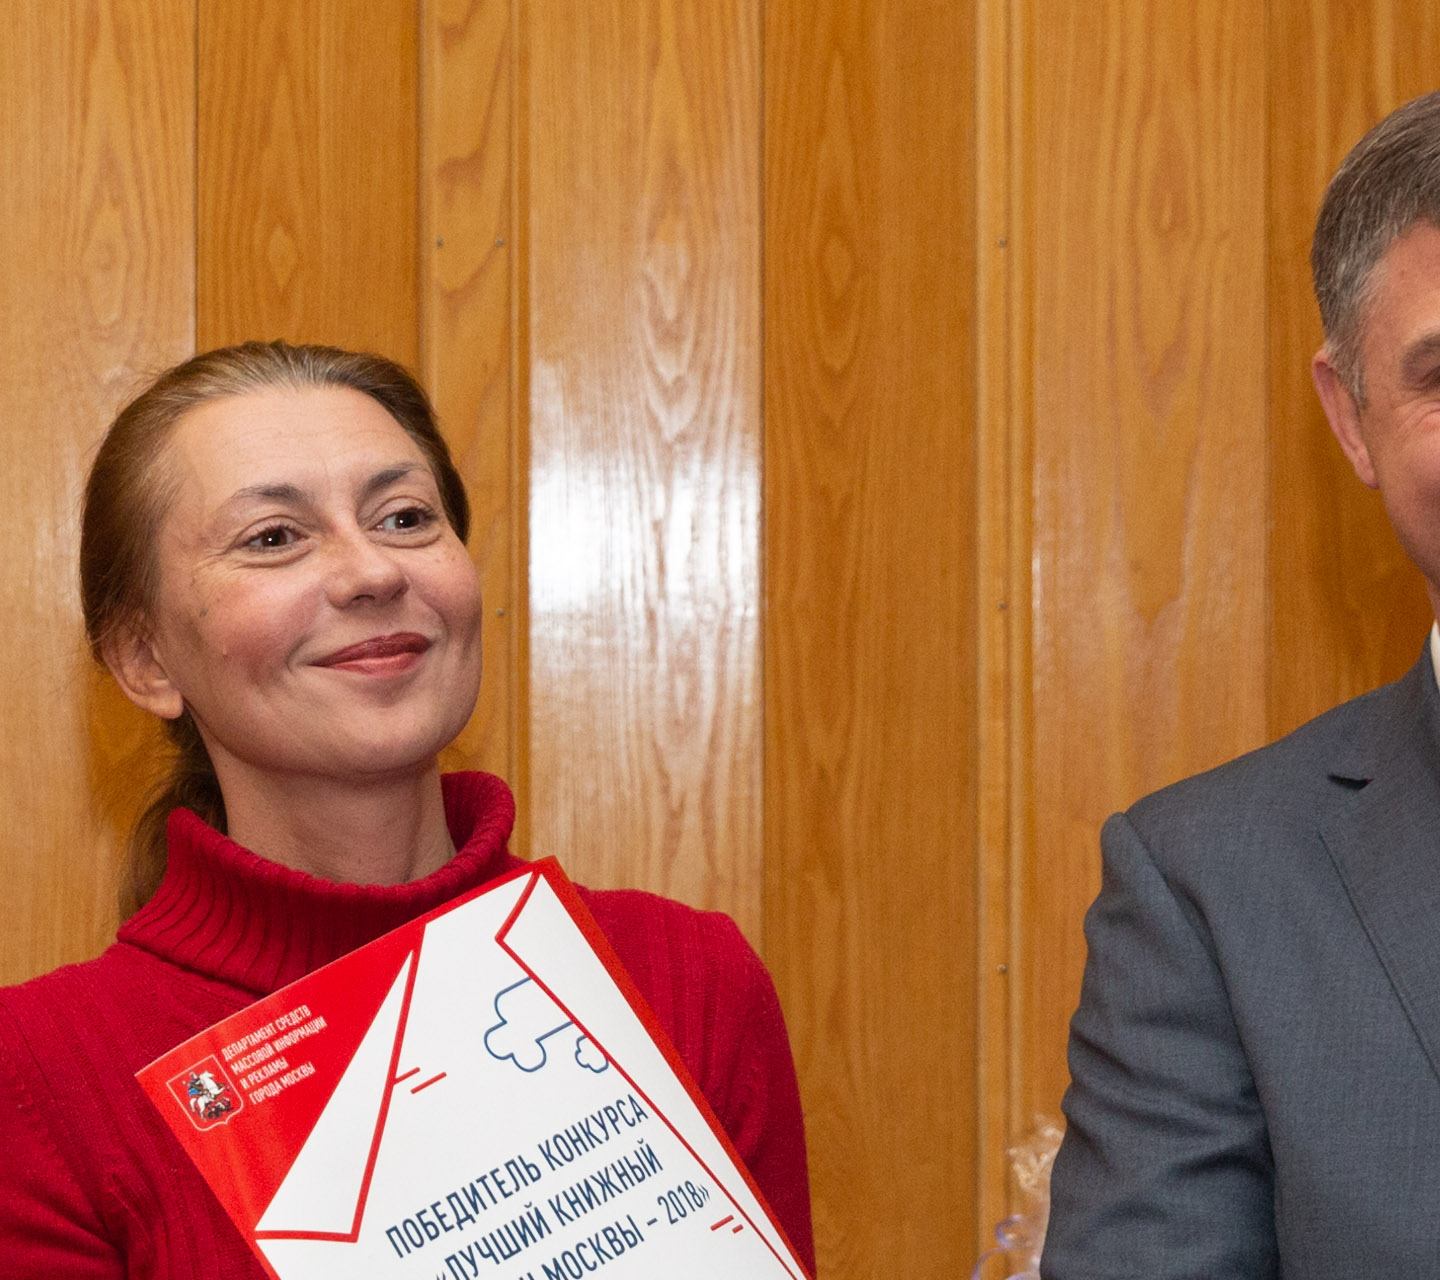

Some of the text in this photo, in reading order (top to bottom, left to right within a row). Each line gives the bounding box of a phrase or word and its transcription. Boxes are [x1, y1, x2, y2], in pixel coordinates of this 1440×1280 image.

[221, 1004, 311, 1061] ДЕПАРТАМЕНТ СРЕДСТВ
[230, 1016, 327, 1075] МАССОВОЙ ИНФОРМАЦИИ
[240, 1057, 289, 1090] И РЕКЛАМЫ
[249, 1061, 316, 1104] ГОРОДА МОСКВЫ
[385, 1093, 649, 1259] ПОБЕДИТЕЛЬ КОНКУРСА
[547, 1138, 664, 1227] КНИЖНЫЙ
[656, 1179, 711, 1226] 2018»
